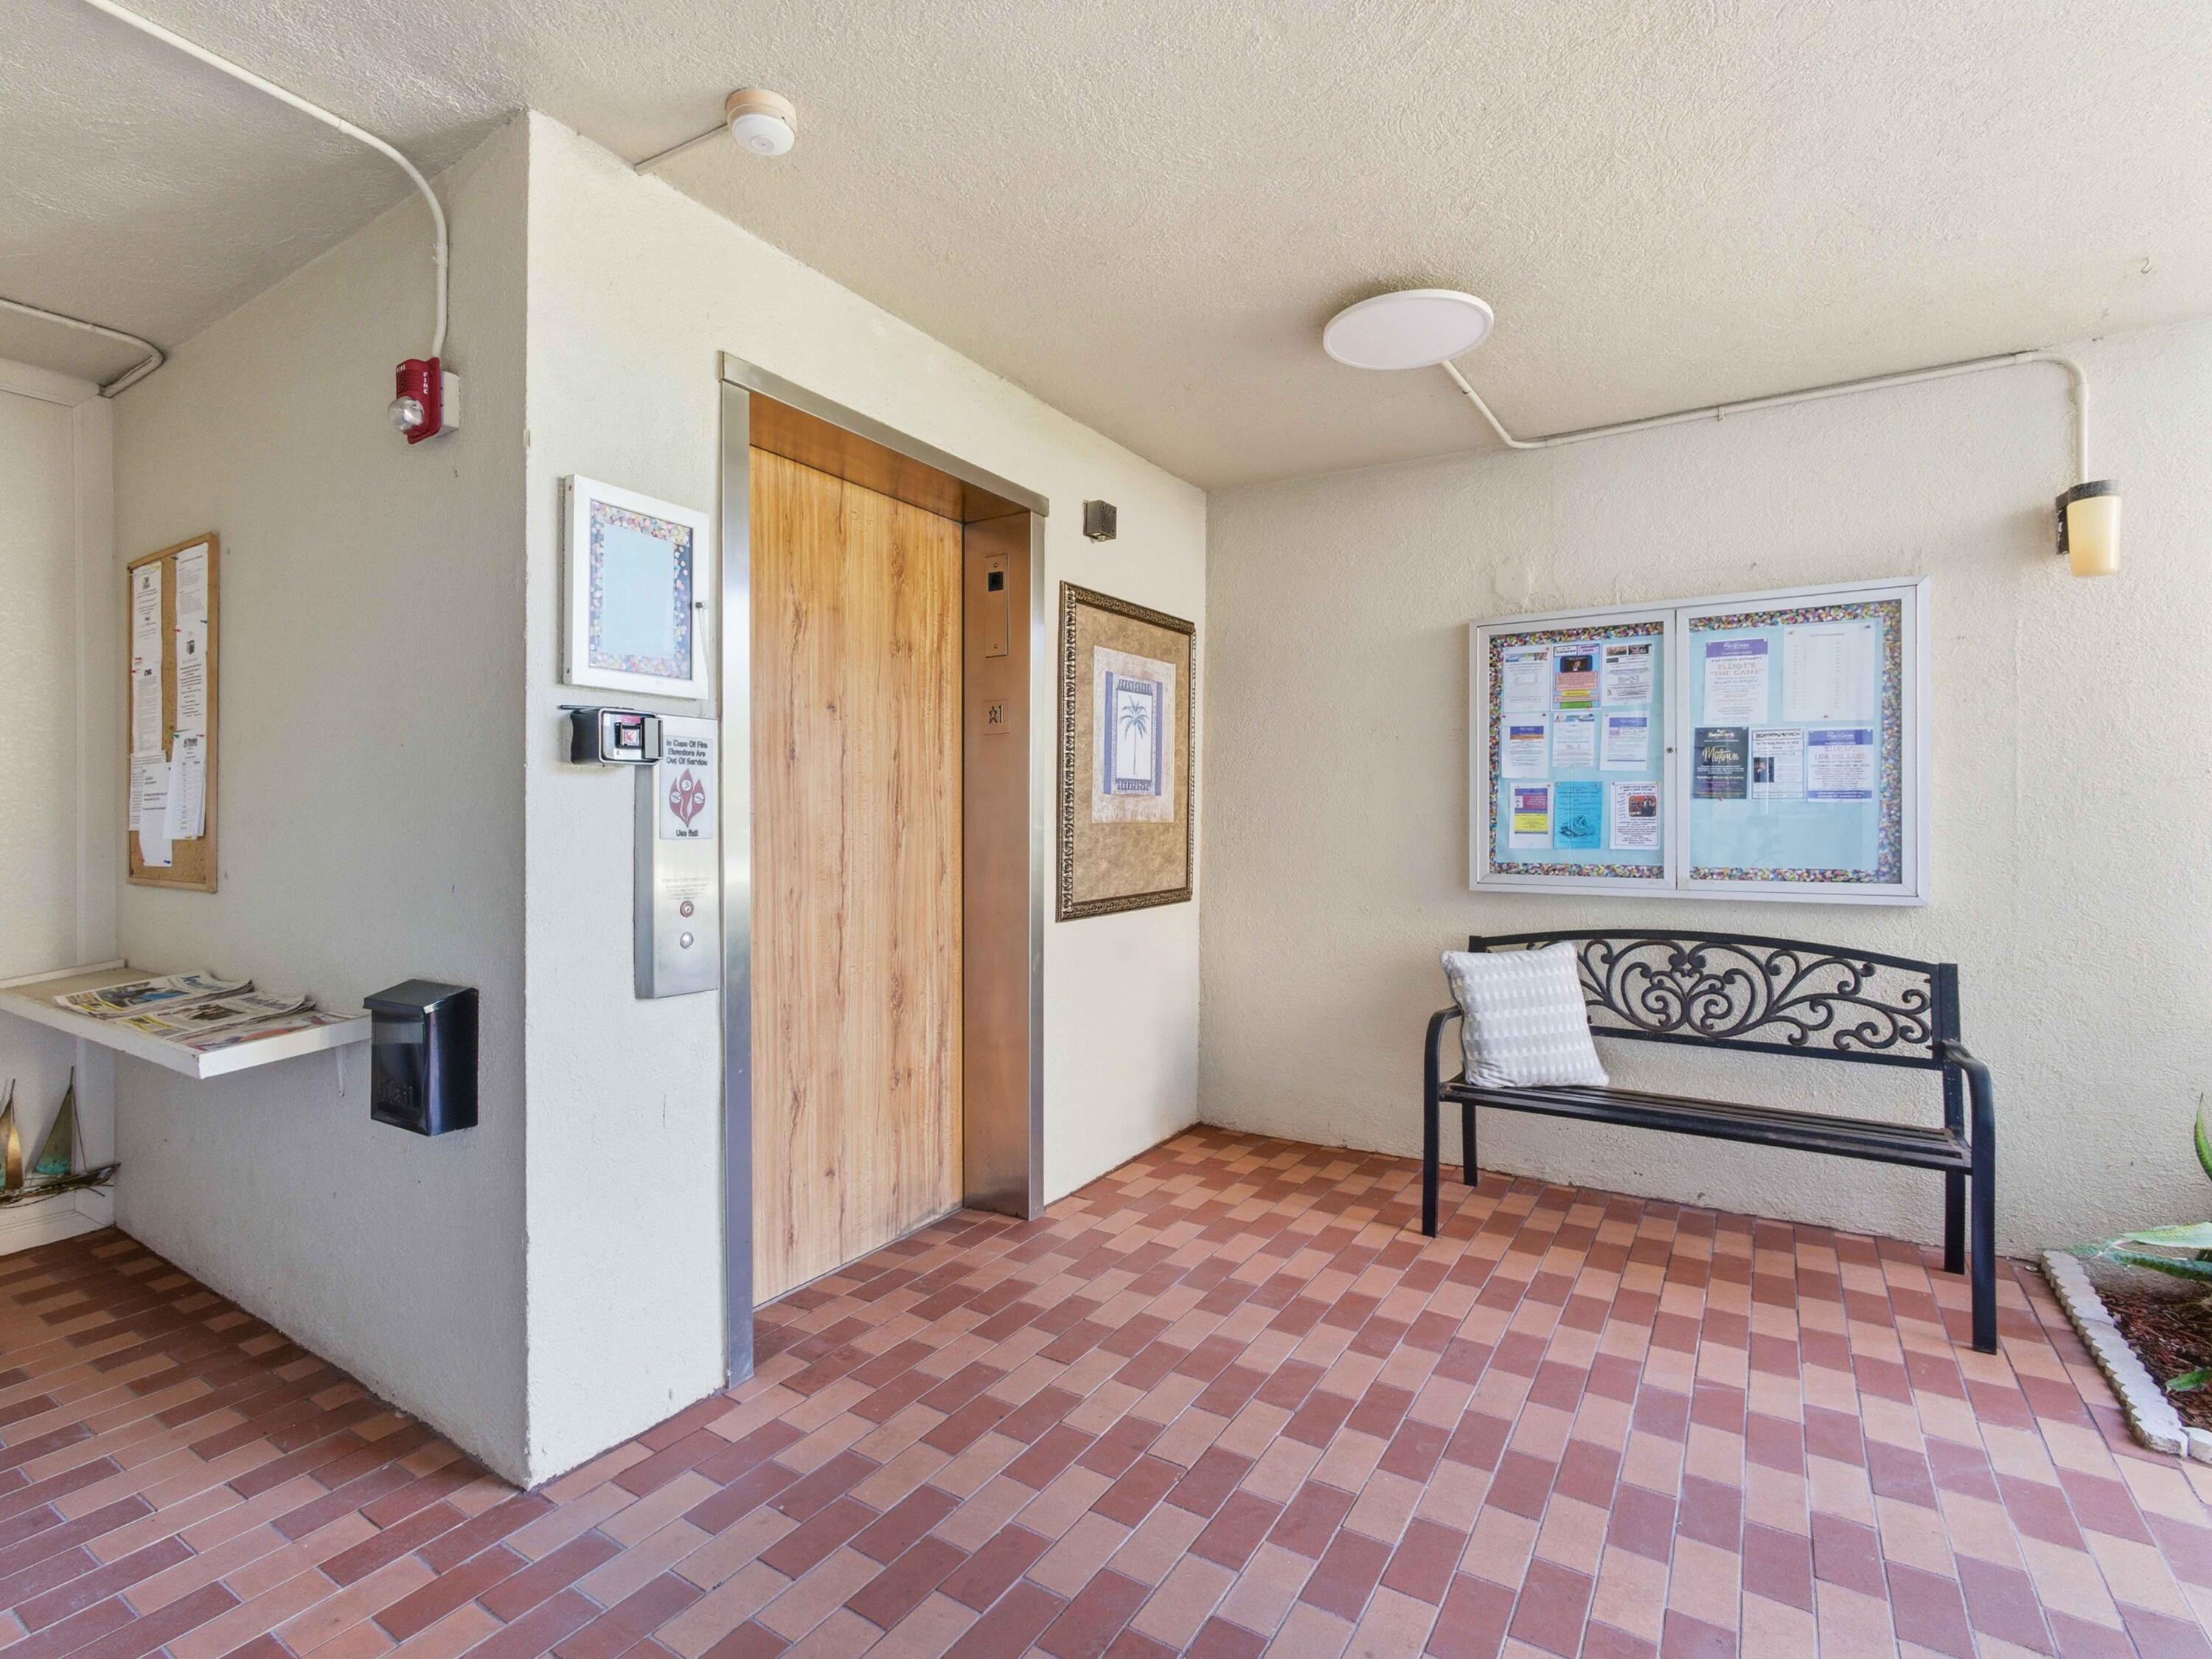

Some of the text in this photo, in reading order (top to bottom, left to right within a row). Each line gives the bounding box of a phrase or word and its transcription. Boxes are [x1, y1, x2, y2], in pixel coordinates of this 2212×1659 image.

[666, 738, 672, 746] In
[673, 739, 688, 747] Case
[697, 741, 708, 749] Fire
[668, 748, 695, 757] Elevators
[666, 757, 677, 765] Out
[686, 758, 708, 766] Service
[675, 829, 687, 837] Use
